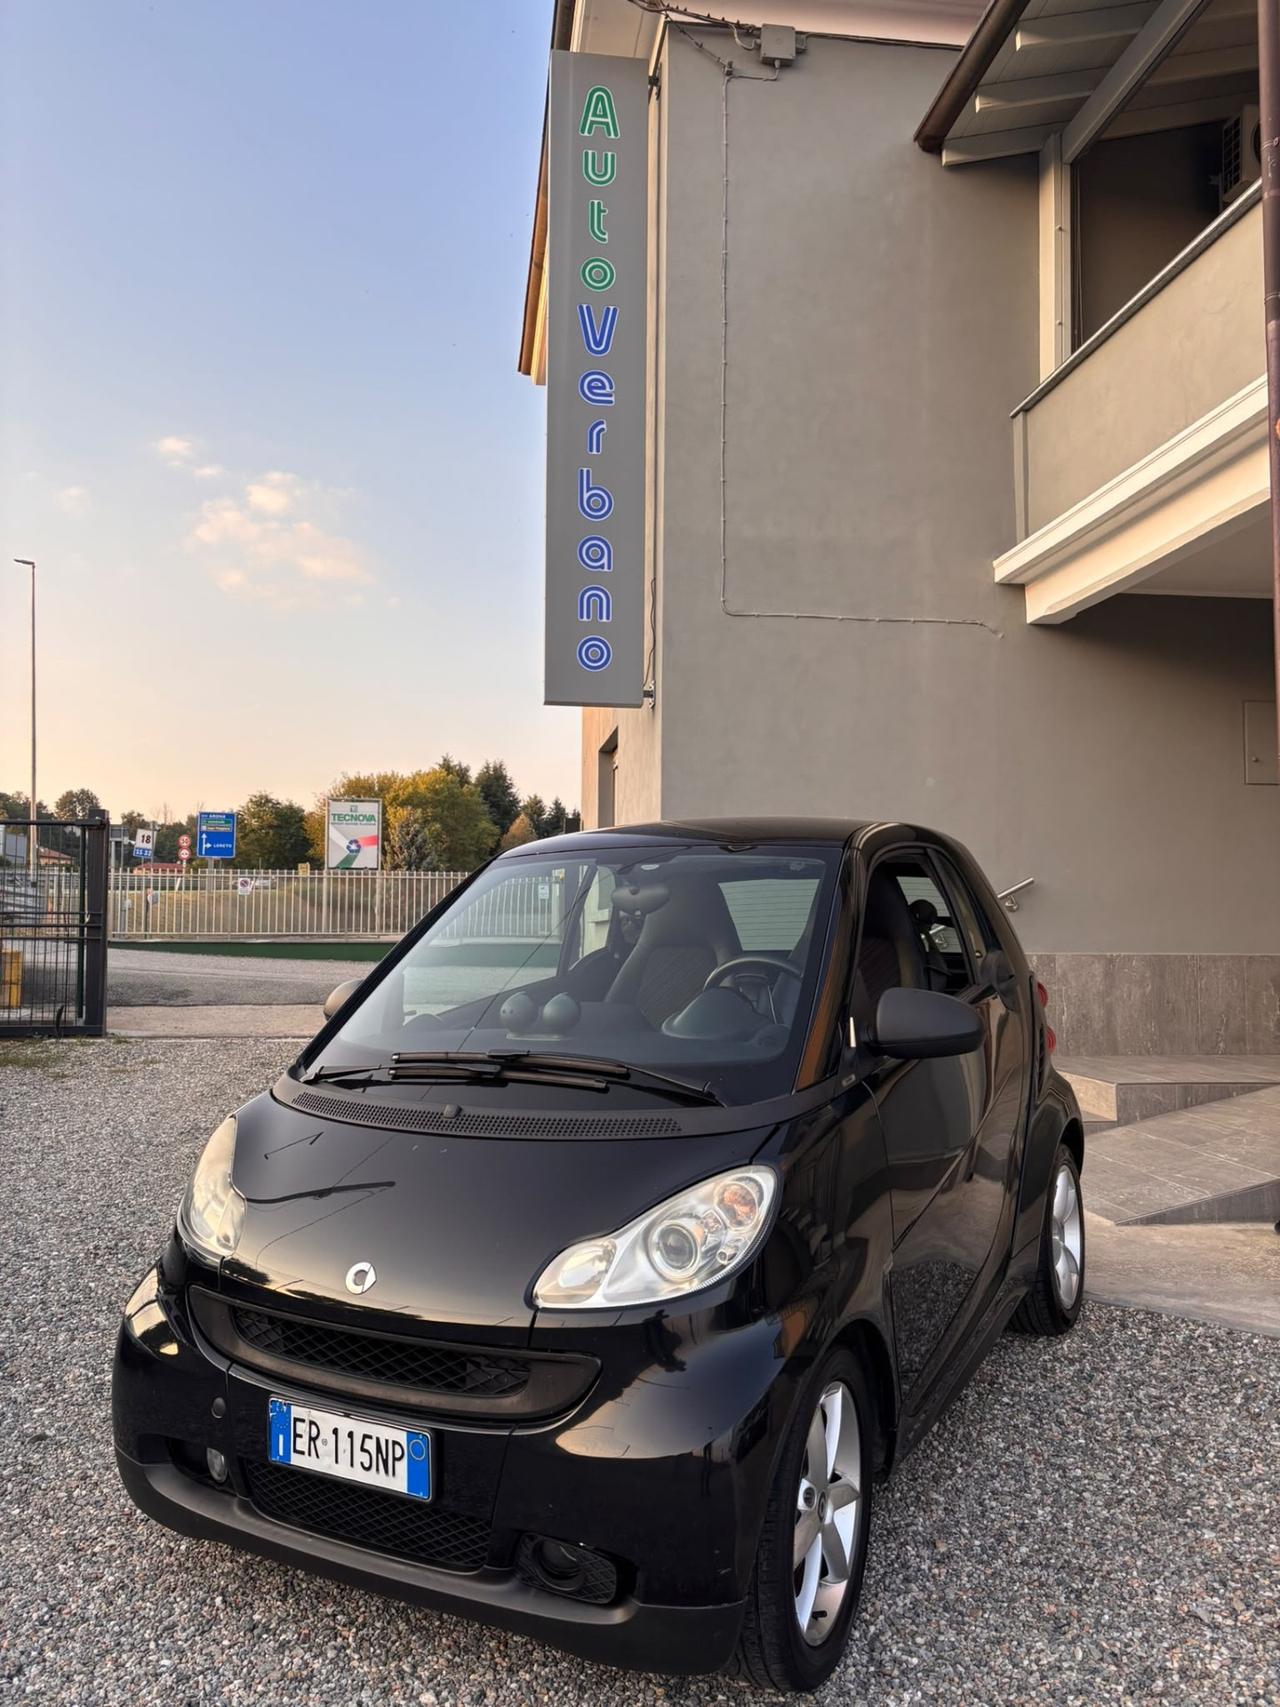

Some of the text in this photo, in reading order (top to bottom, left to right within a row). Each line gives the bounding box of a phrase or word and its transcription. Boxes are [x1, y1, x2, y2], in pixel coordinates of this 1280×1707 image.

[331, 813, 376, 822] TECNOVA
[141, 834, 151, 844] 18
[293, 1416, 320, 1459] ER
[332, 1427, 405, 1478] 115NP
